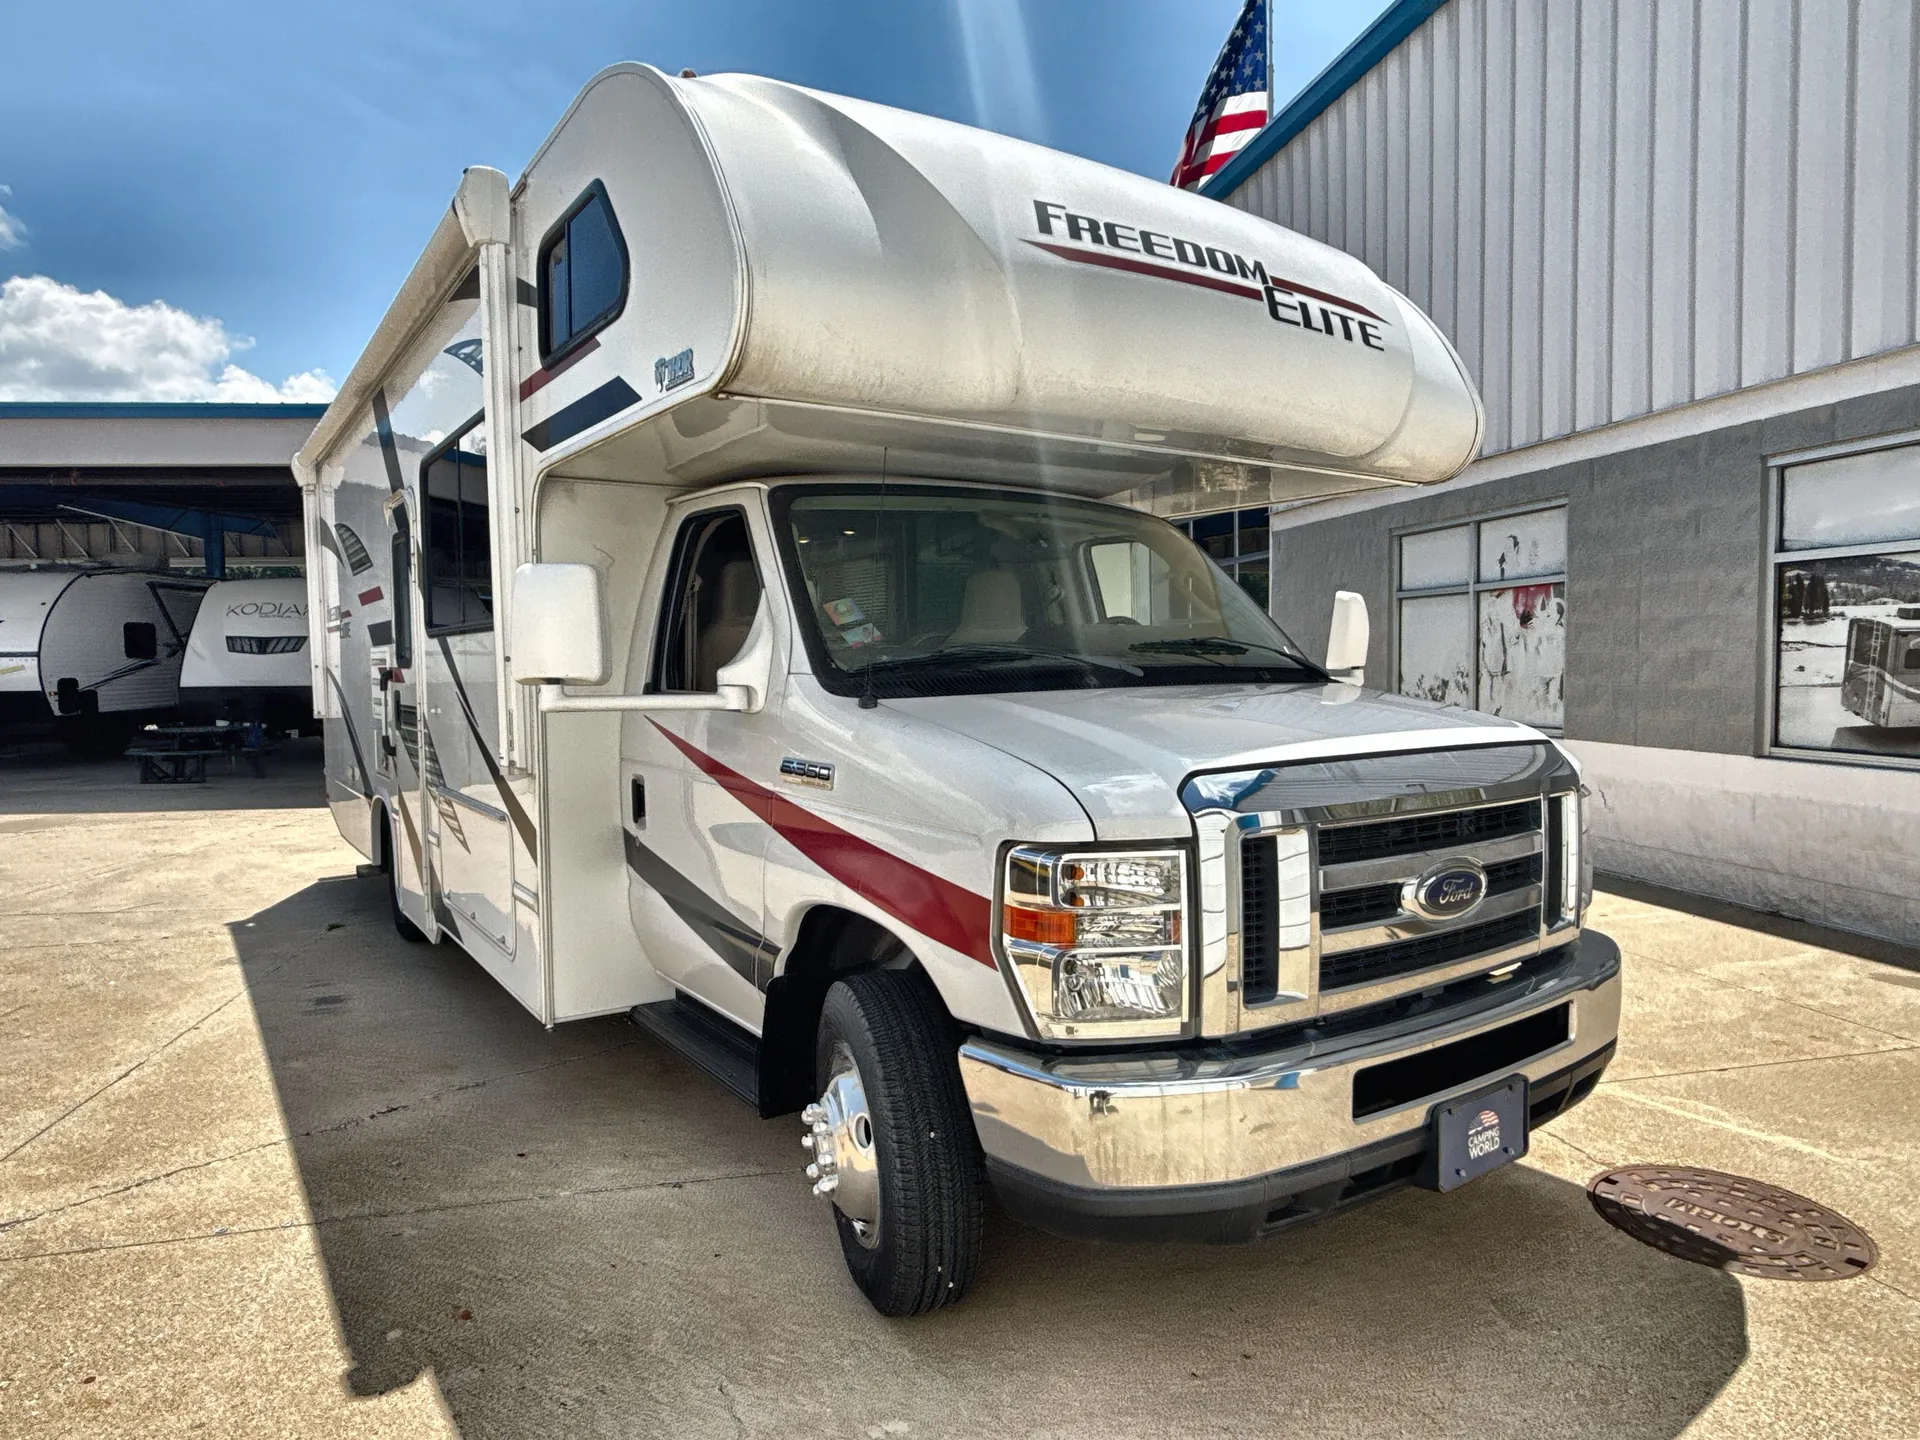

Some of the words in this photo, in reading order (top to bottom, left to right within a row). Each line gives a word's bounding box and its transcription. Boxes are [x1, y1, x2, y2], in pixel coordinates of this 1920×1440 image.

[1033, 199, 1270, 286] FREEDOM
[1263, 285, 1385, 352] ELITE
[1439, 877, 1475, 905] Ford
[1467, 1126, 1500, 1148] CAMPING
[1468, 1136, 1500, 1160] WORLD
